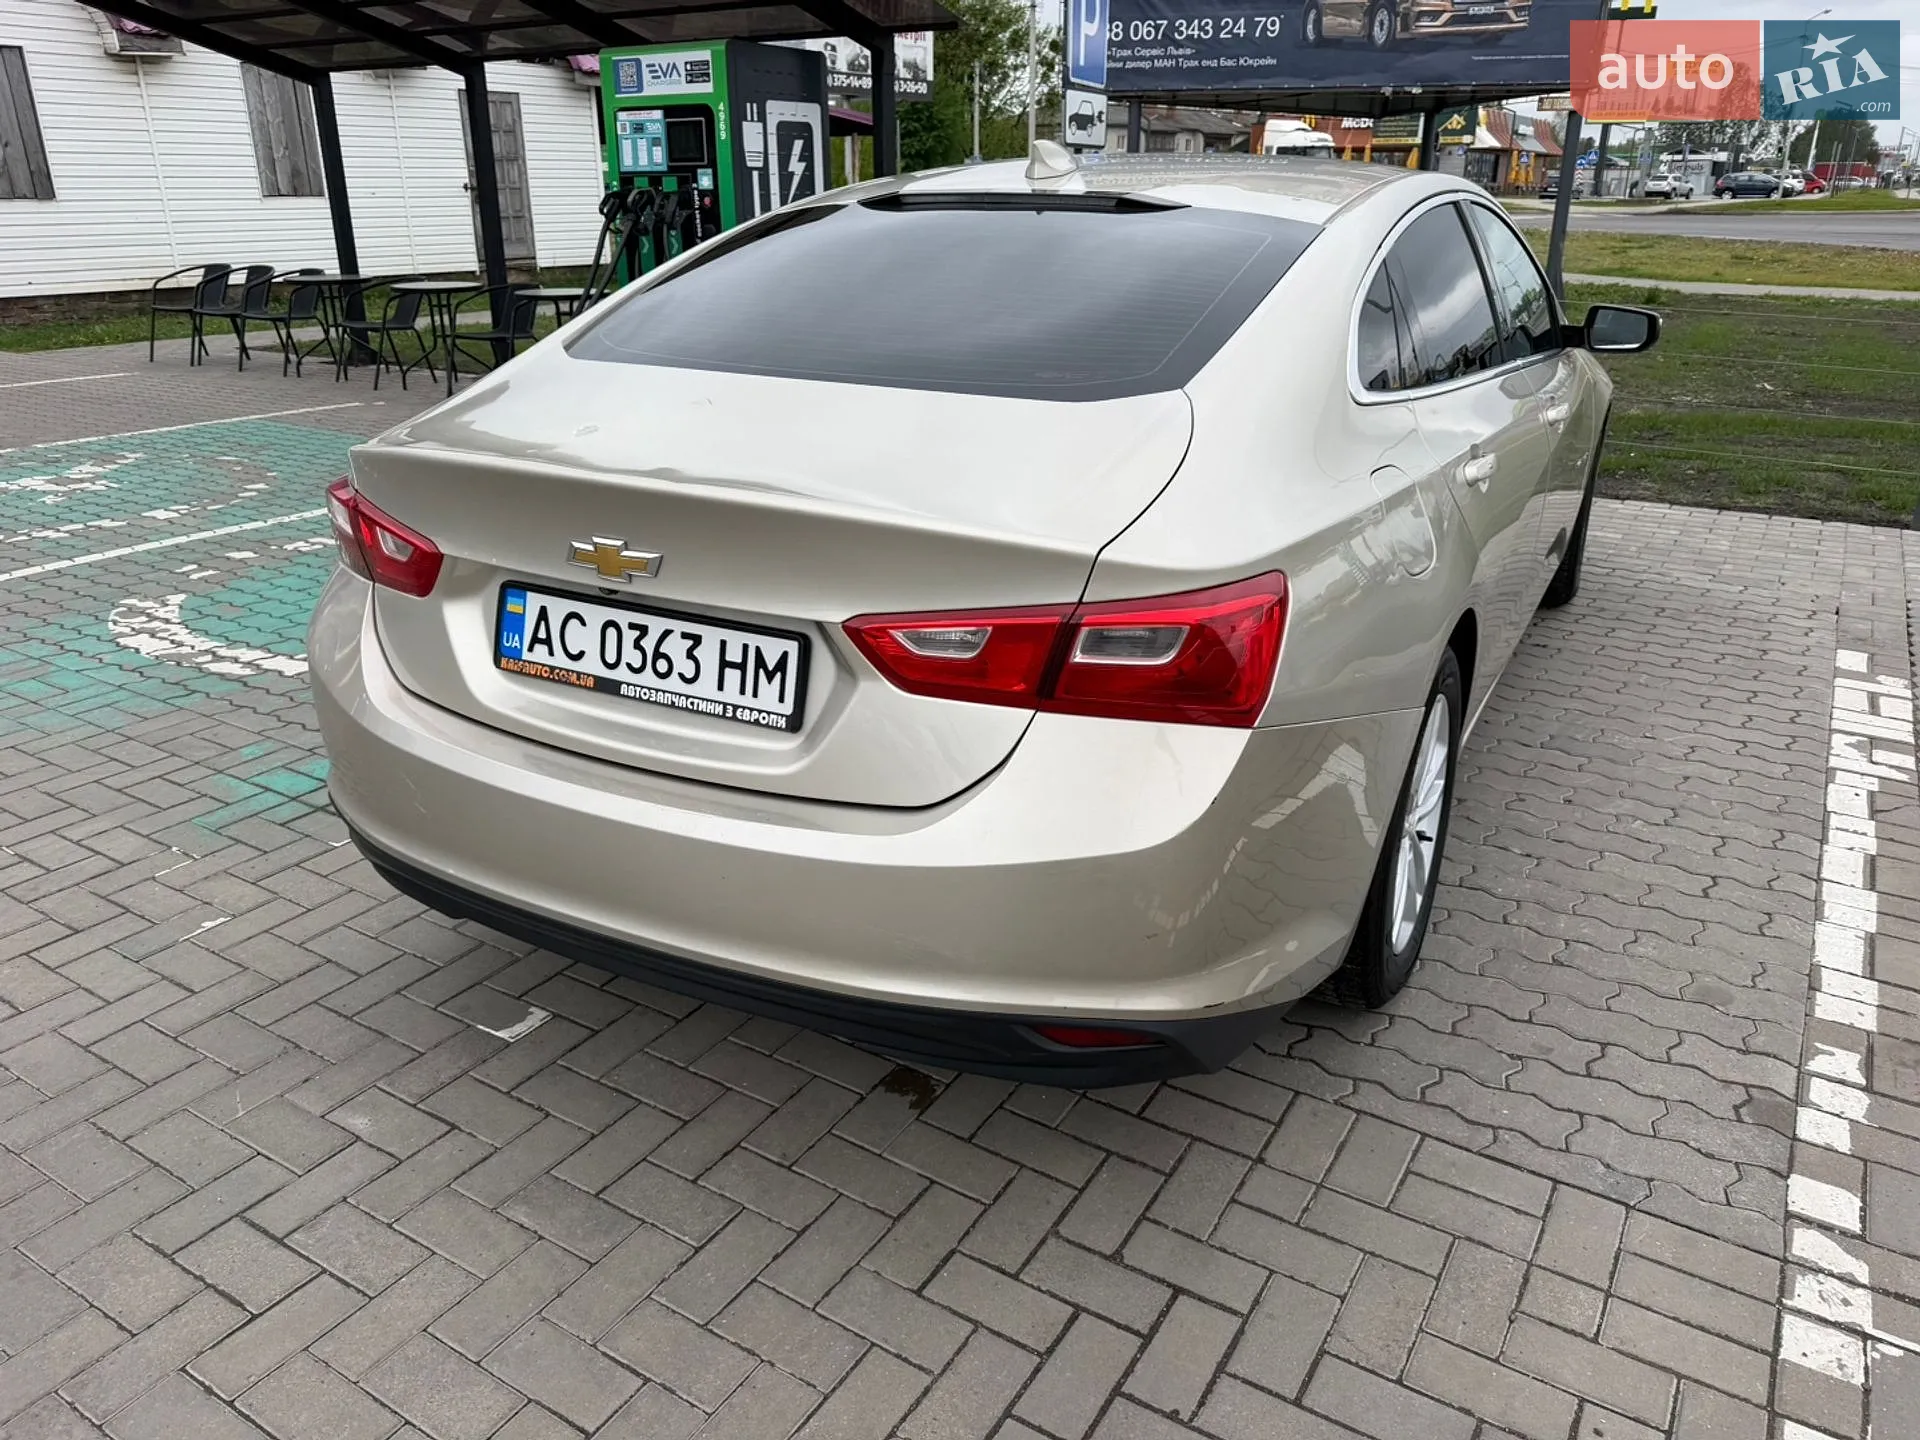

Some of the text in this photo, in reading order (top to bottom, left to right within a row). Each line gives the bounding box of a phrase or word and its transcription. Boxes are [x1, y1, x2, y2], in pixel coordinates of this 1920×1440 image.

[1129, 19, 1168, 41] 067
[1174, 18, 1213, 40] 343
[1219, 17, 1246, 38] 24
[1134, 46, 1165, 57] Сервіс
[645, 62, 681, 80] EVA
[1125, 60, 1153, 69] дилер
[1154, 59, 1176, 67] МАН
[1178, 58, 1199, 69] Трак
[1220, 57, 1237, 66] Бас
[1239, 56, 1277, 67] Юкрейн
[503, 630, 521, 650] UA
[526, 605, 791, 704] AC 0363 HM
[619, 683, 724, 716] АВТОЗАПЧАСТИНИ
[735, 709, 787, 729] ЄВРОПИ
